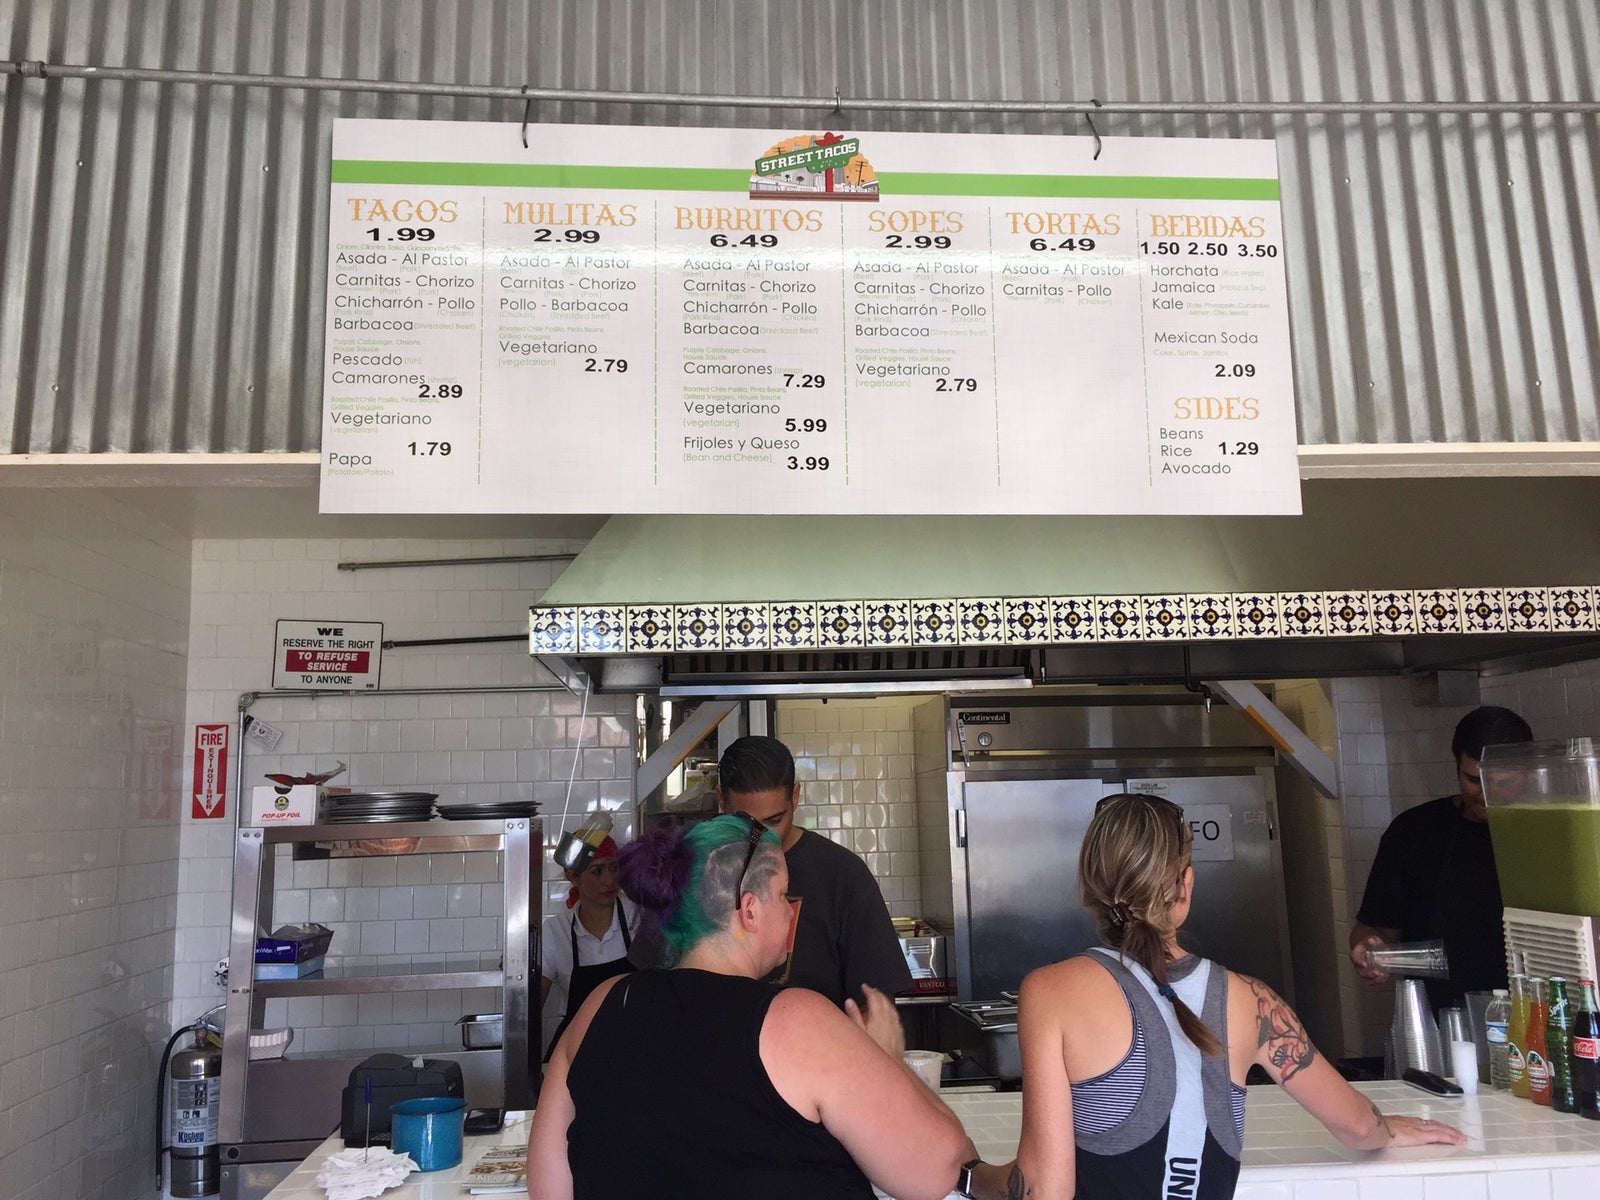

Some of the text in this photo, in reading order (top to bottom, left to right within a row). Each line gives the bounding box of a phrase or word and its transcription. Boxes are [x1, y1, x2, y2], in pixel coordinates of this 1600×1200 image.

[761, 151, 814, 172] STREET
[815, 142, 857, 160] TACOS
[348, 198, 458, 223] TACOS
[503, 201, 638, 227] MULITAS
[674, 205, 824, 232] BURRITOS
[868, 210, 964, 234] SOPES
[1006, 211, 1121, 235] TORTAS
[1150, 213, 1266, 238] BEBIDAS
[366, 227, 436, 242] 1.99
[534, 228, 600, 244] 2.99
[710, 234, 778, 248] 6.49
[885, 235, 952, 250] 2.99
[1030, 238, 1096, 252] 6.49
[1140, 242, 1278, 258] 1.50 2.50 3.50
[336, 252, 468, 266] Asada Al Pastor
[500, 255, 631, 268] Asada Al Pastor
[683, 258, 810, 272] Asada Al Pastor
[854, 261, 978, 274] Asada Al Pastor
[1002, 264, 1125, 276] Asada Al Pastor
[1151, 265, 1218, 276] Horchata
[336, 274, 474, 288] Carnitas Chorizo
[500, 276, 636, 290] Carnitas Chorizo
[684, 279, 816, 293] Carnitas Chorizo
[1152, 281, 1215, 293] Jamaica
[854, 282, 985, 295] Carnitas Chorizo
[1003, 284, 1112, 296] Carnitas Pollo
[334, 296, 475, 310] Chicharrón Pollo
[500, 298, 628, 312] Pollo Barbacoa
[684, 300, 818, 314] Chicharrón Pollo
[855, 302, 986, 316] Chicharrón Pollo
[1152, 298, 1184, 310] Kale
[334, 318, 414, 330] Barbacoa
[684, 323, 760, 335] Barbacoa
[856, 324, 929, 337] Barbacoa
[1154, 332, 1258, 344] Mexican Soda
[500, 340, 598, 356] Vegetariano
[333, 352, 402, 366] Pescado
[584, 358, 628, 373] 2.79
[684, 362, 772, 374] Camarones
[856, 363, 950, 378] Vegetariano
[1215, 364, 1256, 378] 2.09
[332, 371, 426, 384] Camarones
[784, 374, 826, 388] 7.29
[418, 384, 463, 398] 2.89
[936, 378, 978, 392] 2.79
[684, 402, 780, 416] Vegetariano
[1174, 396, 1260, 420] SIDES
[331, 412, 432, 427] Vegetariano
[684, 418, 740, 428] (vegetarian)
[784, 418, 827, 432] 5.99
[1160, 427, 1204, 439] Beans
[408, 442, 452, 456] 1.79
[684, 436, 800, 451] Frijoles y Queso
[1161, 441, 1259, 456] Rice 1.29
[330, 452, 372, 468] Papa
[684, 454, 772, 462] (Bean and Cheese)
[787, 456, 830, 470] 3.99
[1162, 462, 1231, 474] Avocado
[317, 628, 344, 636] WE
[283, 639, 375, 649] RESERVE THE RIGHT
[298, 652, 358, 661] TO REFUSE
[307, 662, 348, 671] SERVICE
[301, 675, 352, 684] TO ANYONE
[963, 713, 1006, 721] Continental
[201, 733, 223, 745] FIRE
[206, 748, 214, 809] EXTINGUISHER
[1168, 1157, 1198, 1200] UN
